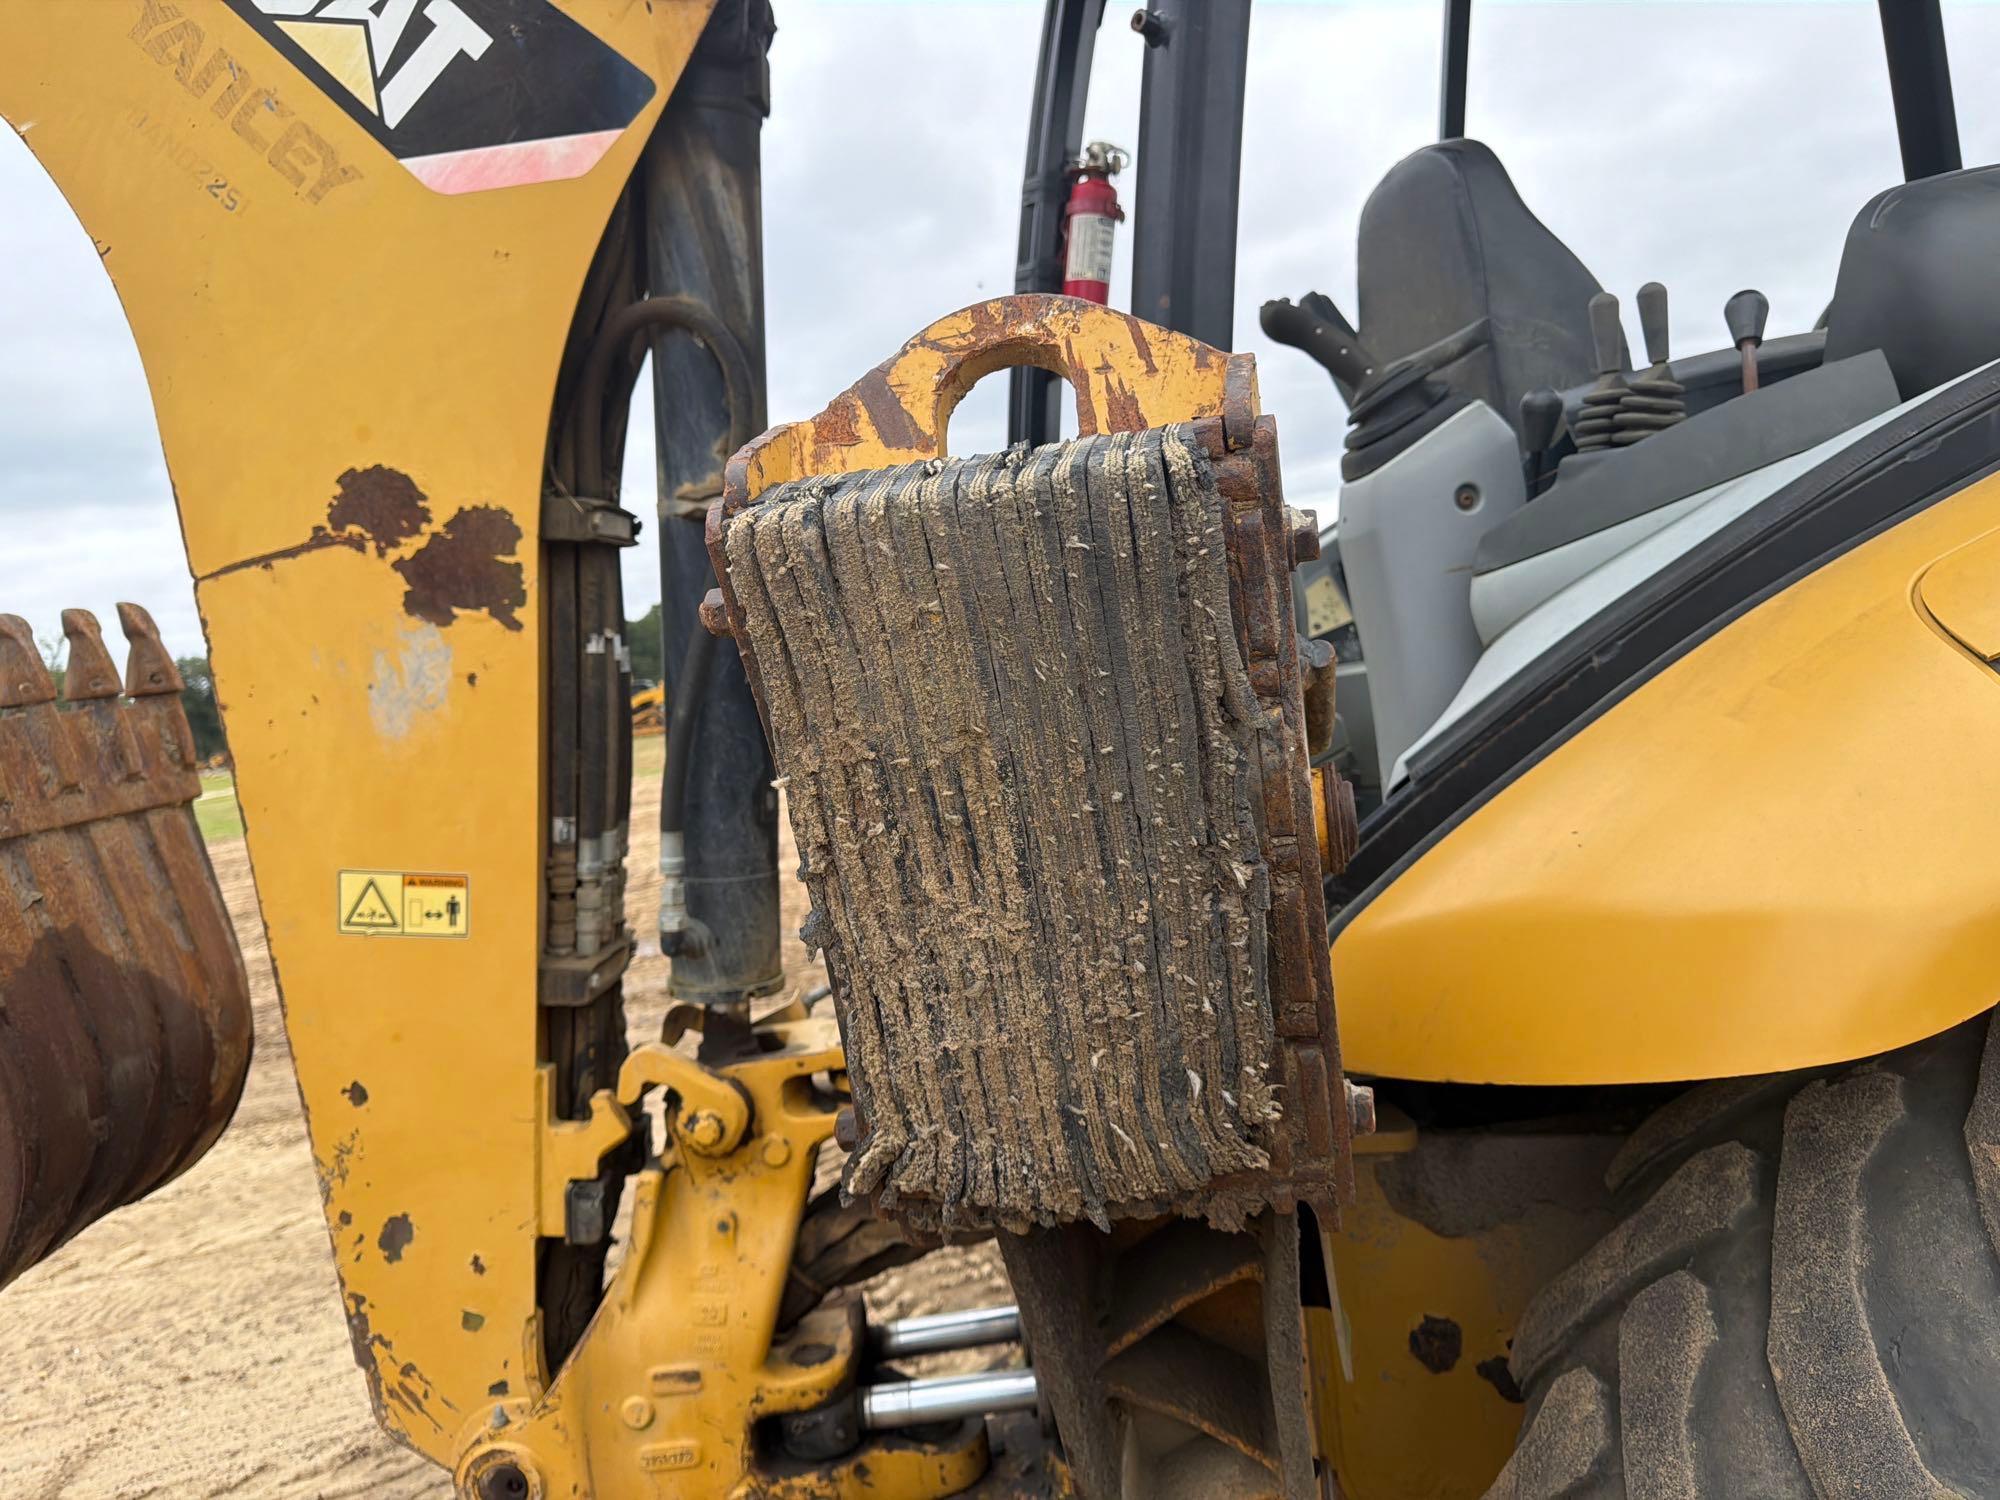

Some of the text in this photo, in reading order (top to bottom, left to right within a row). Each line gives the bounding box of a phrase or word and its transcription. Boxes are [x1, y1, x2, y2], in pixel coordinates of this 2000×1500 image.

[127, 0, 364, 206] YANCEY
[253, 0, 494, 130] AT
[418, 878, 464, 889] WARNING
